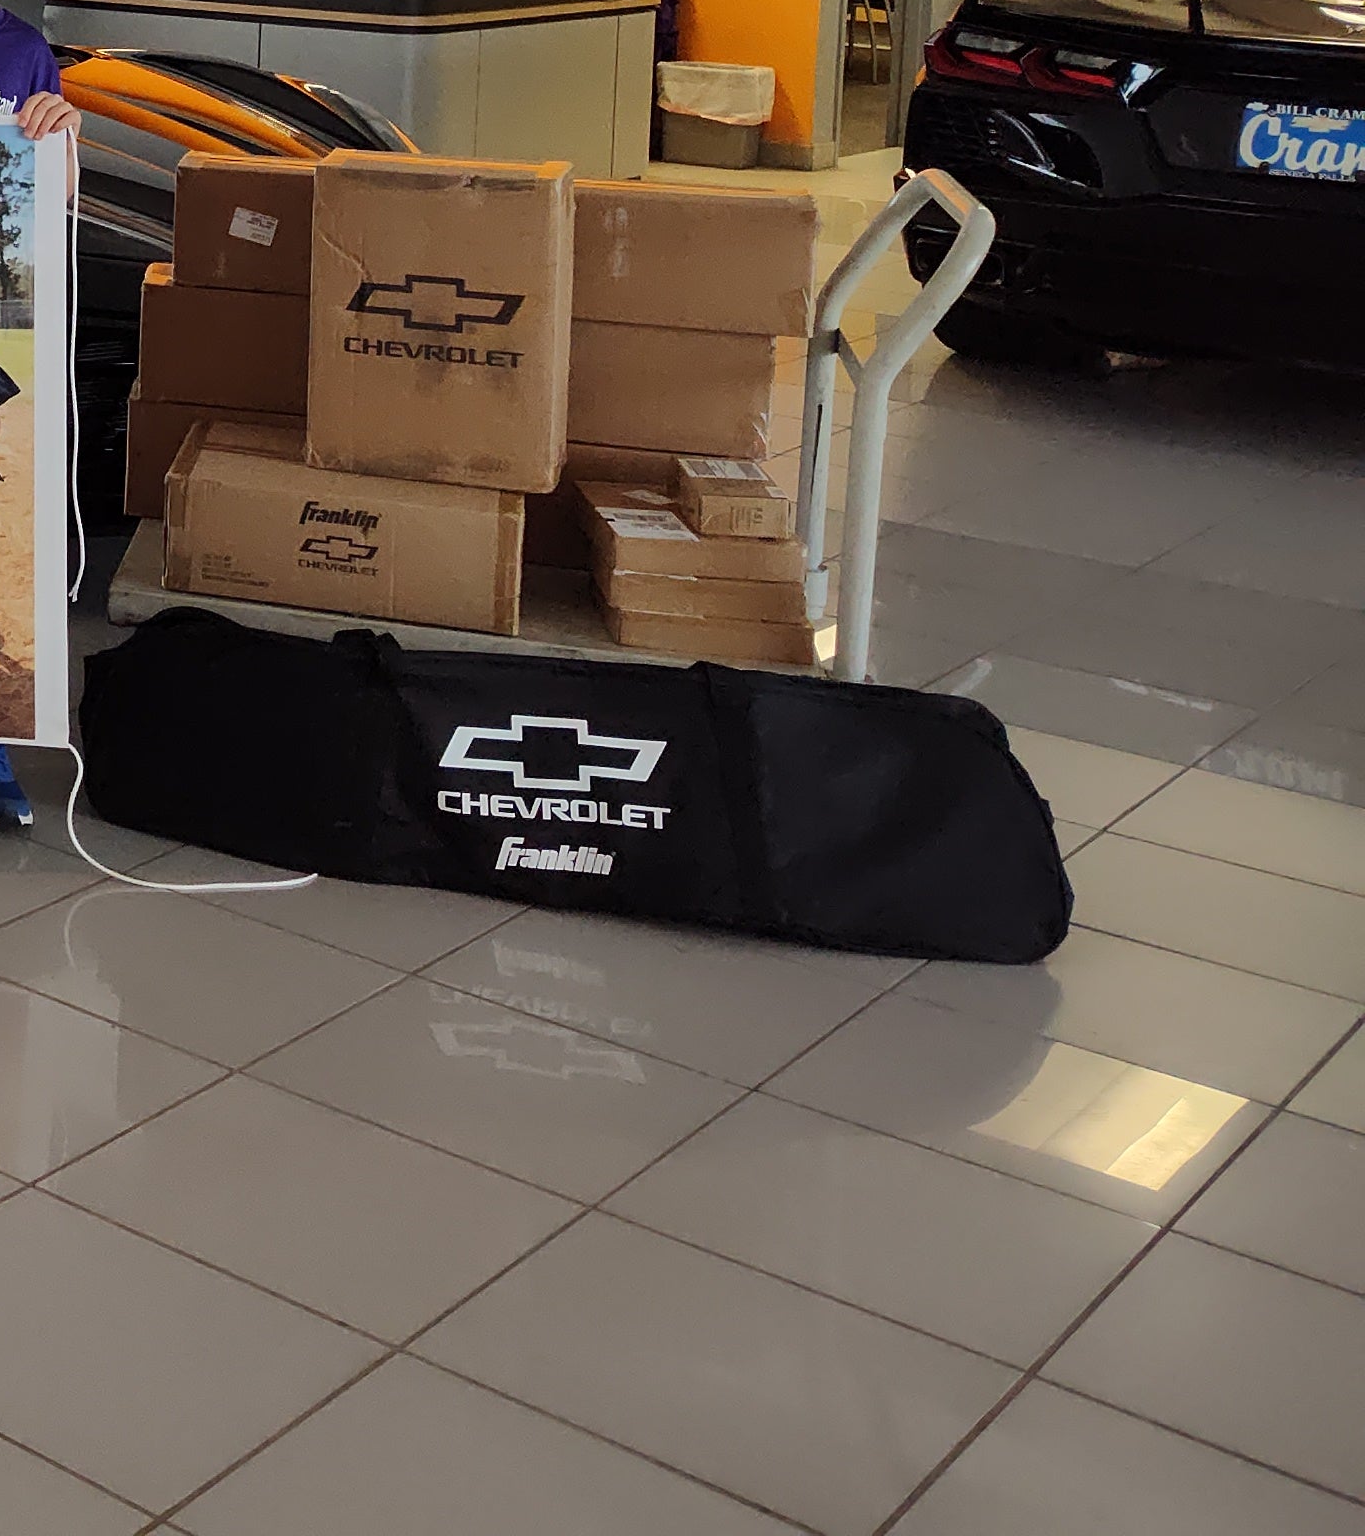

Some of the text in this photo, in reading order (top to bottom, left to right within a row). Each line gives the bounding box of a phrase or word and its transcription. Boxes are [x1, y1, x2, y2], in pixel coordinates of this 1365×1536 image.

[1276, 103, 1312, 116] BILL
[343, 336, 525, 369] CHEVROLET
[297, 558, 379, 578] CHEVROLET
[437, 790, 671, 830] CHEVROLET
